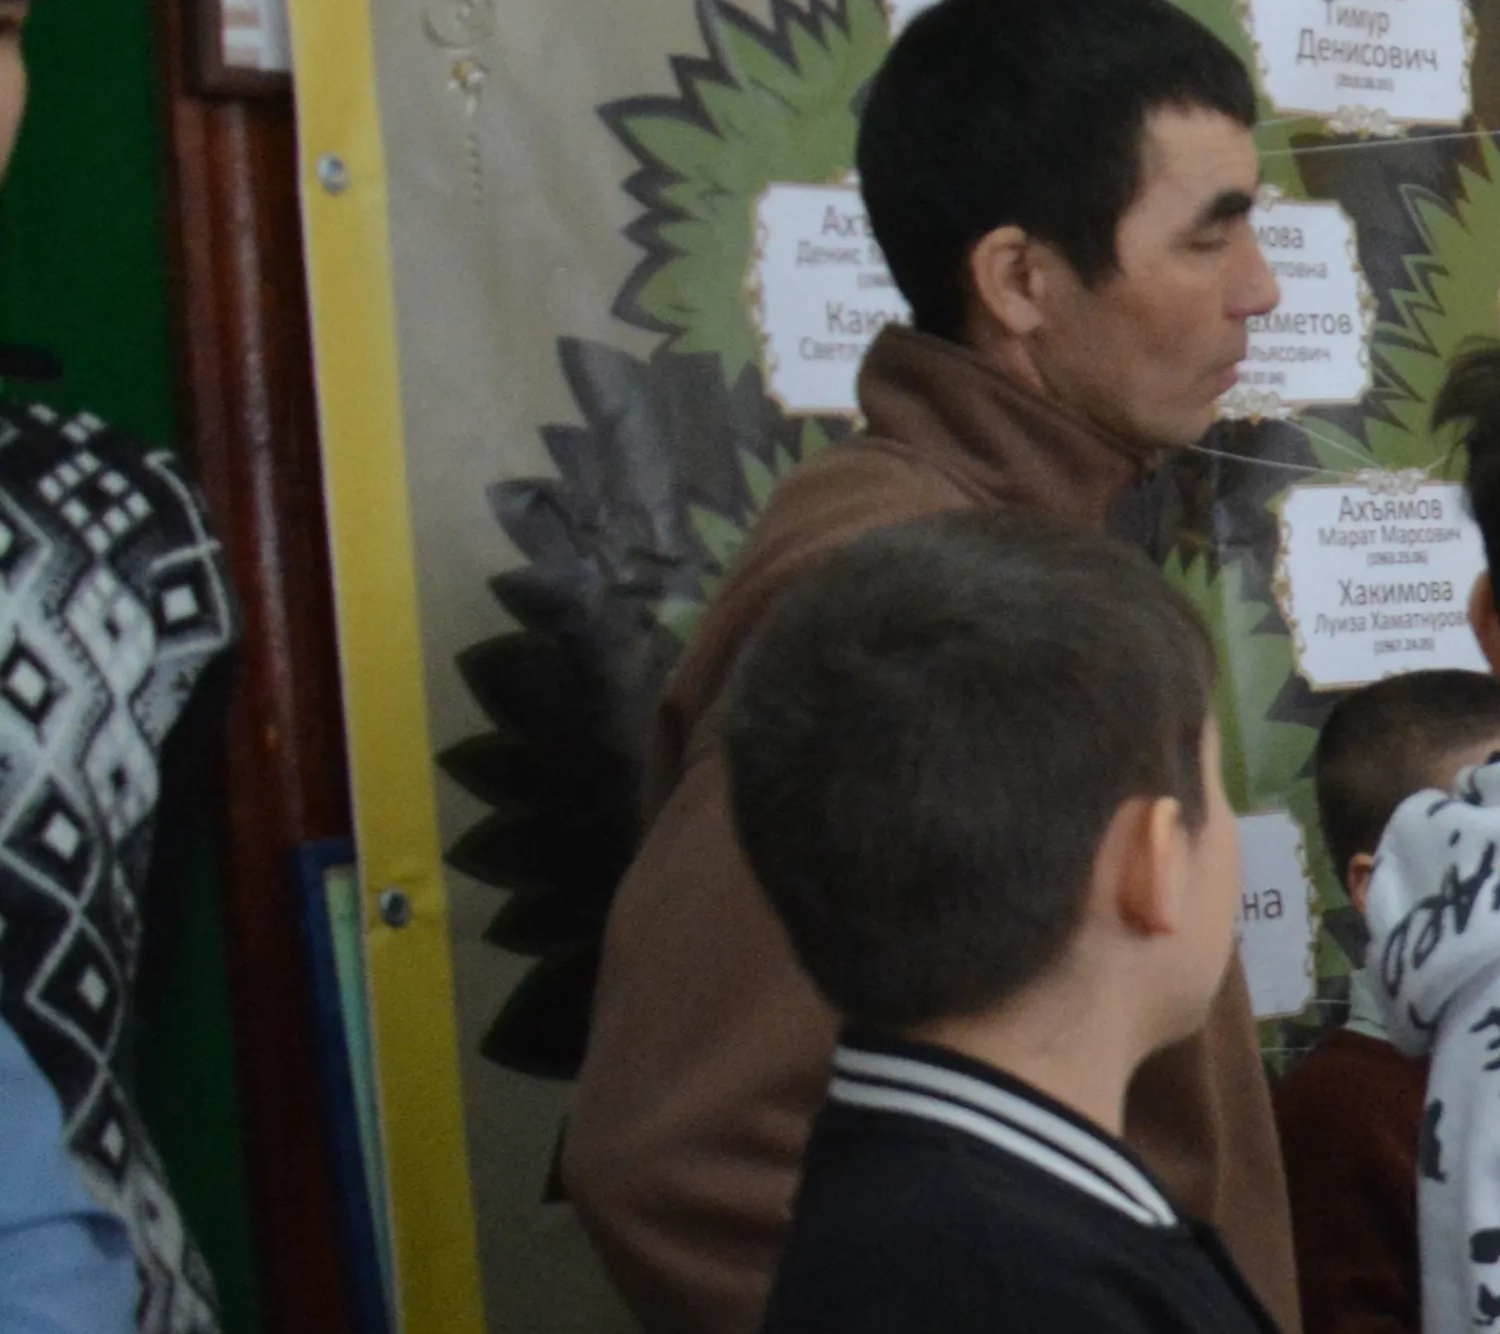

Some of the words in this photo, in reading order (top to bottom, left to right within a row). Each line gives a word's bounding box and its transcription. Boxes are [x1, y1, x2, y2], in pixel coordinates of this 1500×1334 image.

[1296, 28, 1439, 71] Денисович
[1338, 495, 1444, 522] Ахъямов
[1338, 578, 1455, 607] Хакимова
